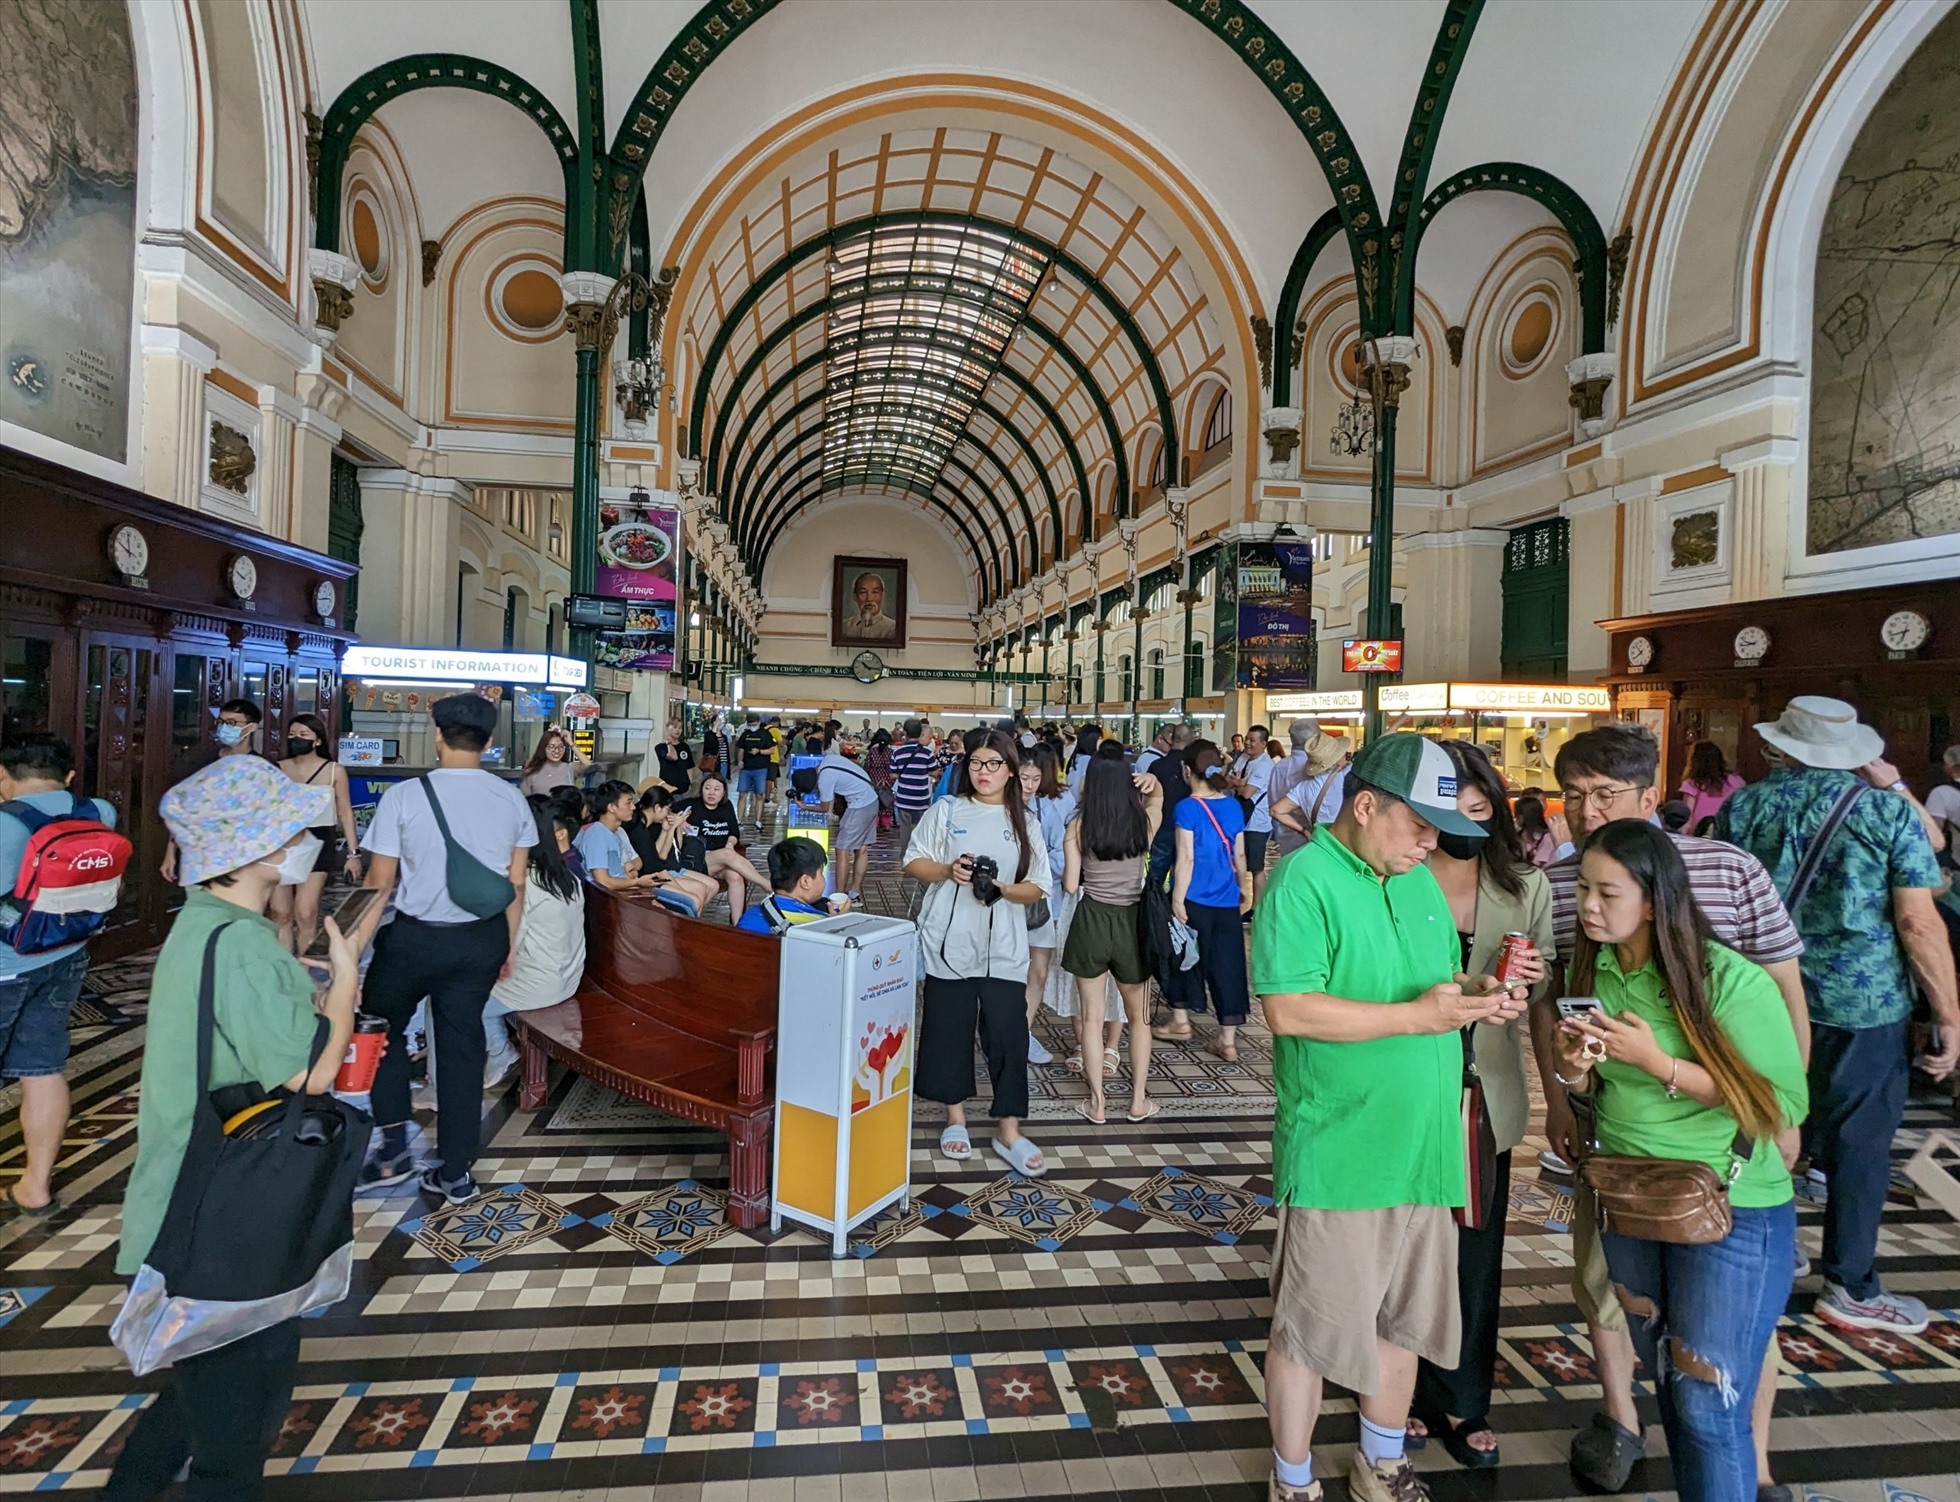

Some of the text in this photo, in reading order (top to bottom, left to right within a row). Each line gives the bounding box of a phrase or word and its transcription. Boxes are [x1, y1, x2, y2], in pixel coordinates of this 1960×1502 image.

[361, 656, 539, 674] TOURIST INFORMATION
[960, 671, 977, 679] MINH
[1270, 698, 1283, 708] BEST
[1311, 697, 1317, 706] IN
[1319, 695, 1331, 706] THE
[1333, 694, 1357, 706] WORLD
[1381, 688, 1410, 702] Coffee
[1476, 689, 1537, 704] COFFEE
[1541, 692, 1573, 705] AND
[339, 741, 380, 750] SIM CARD
[76, 856, 109, 870] CMS
